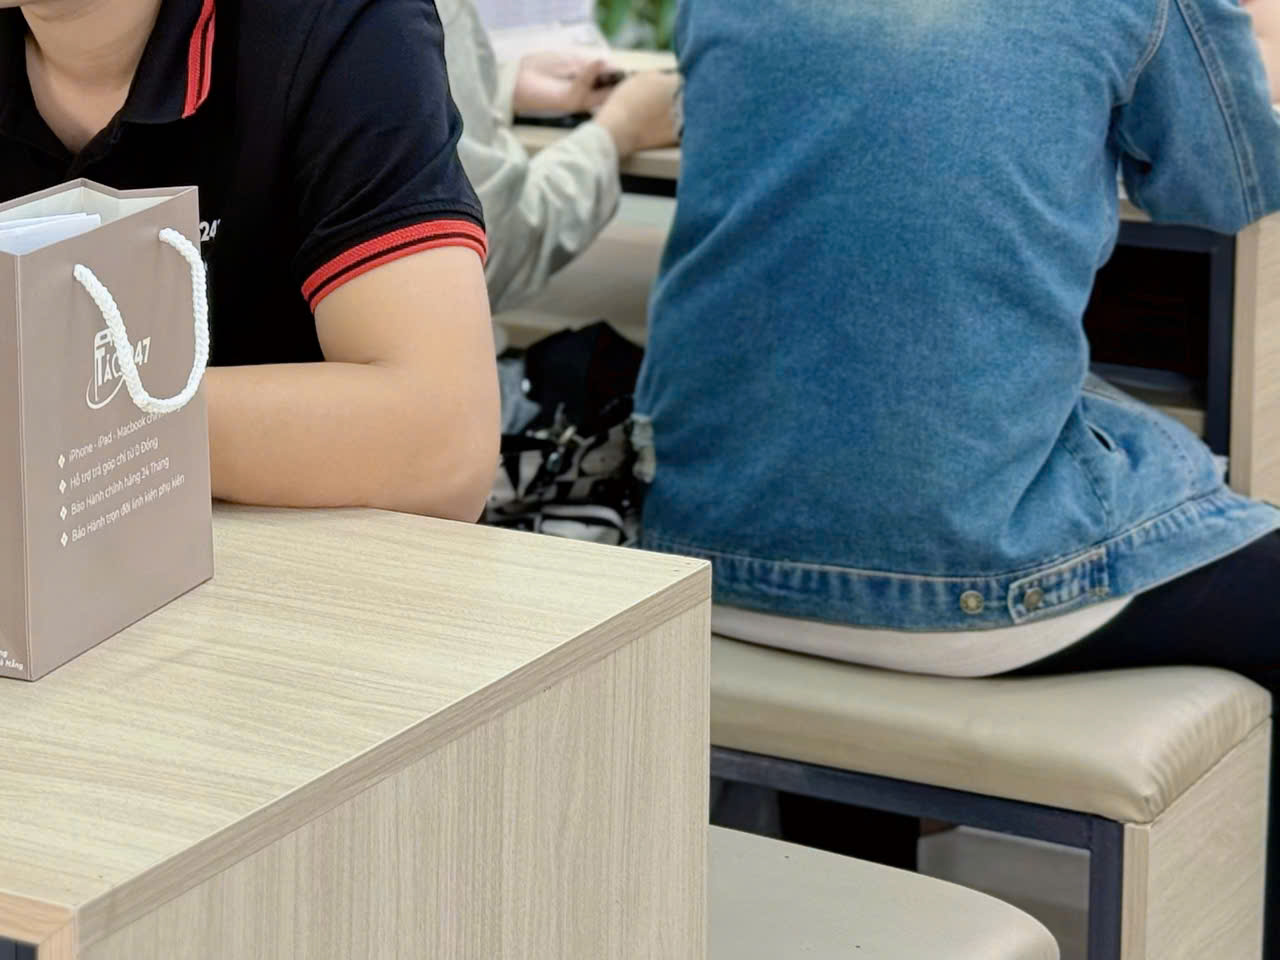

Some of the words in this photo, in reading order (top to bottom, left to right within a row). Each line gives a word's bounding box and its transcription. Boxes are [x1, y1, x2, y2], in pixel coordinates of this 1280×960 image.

[199, 218, 221, 242] 24
[69, 443, 93, 462] iPhone
[98, 432, 112, 448] iPad
[117, 415, 145, 440] Macbook
